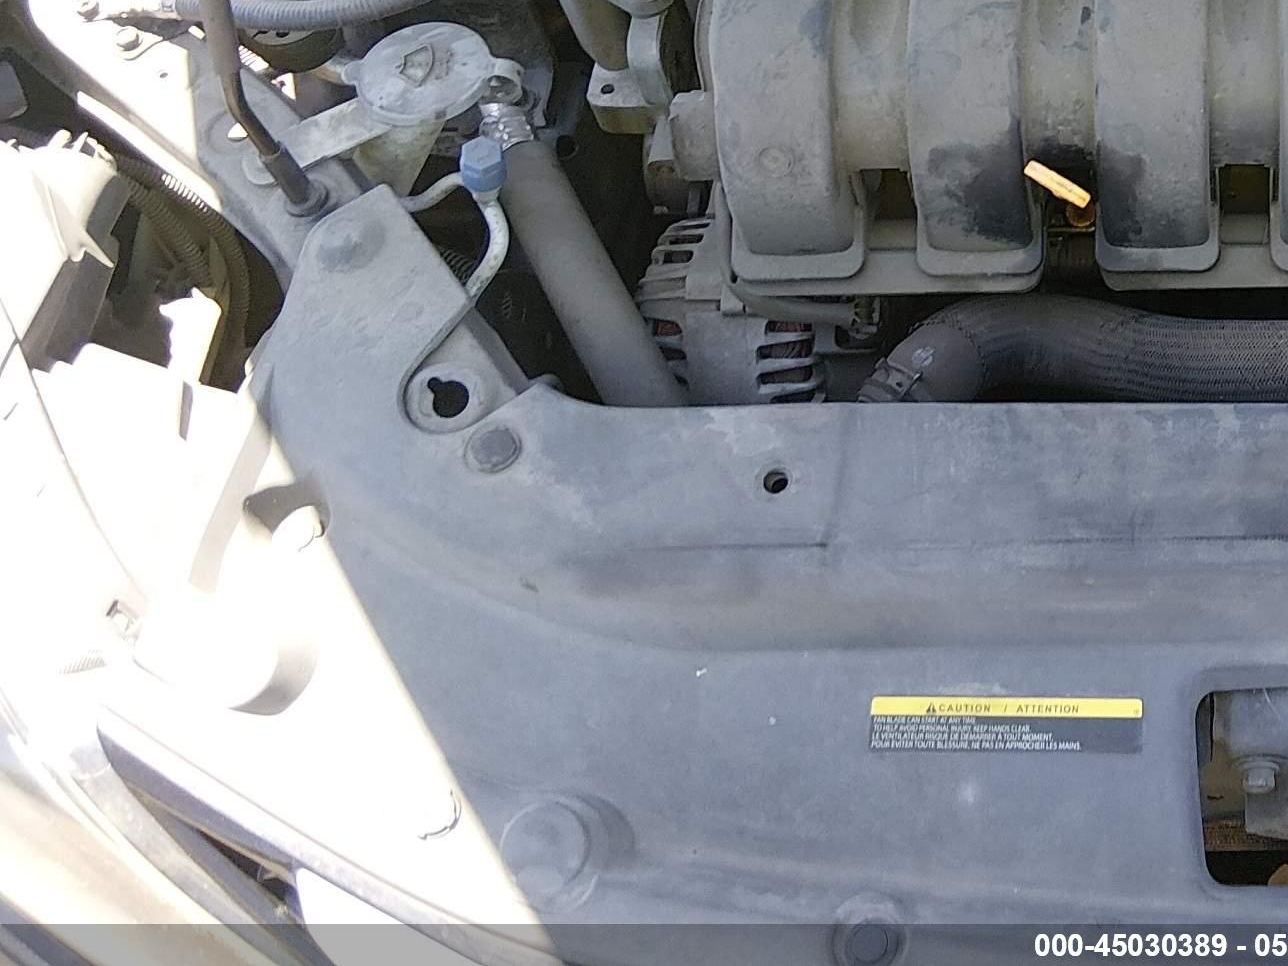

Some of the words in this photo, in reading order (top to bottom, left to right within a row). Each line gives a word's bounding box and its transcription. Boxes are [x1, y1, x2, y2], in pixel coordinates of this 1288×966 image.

[938, 704, 991, 713] CAUTION
[1016, 704, 1079, 714] ATTENTION
[907, 716, 920, 724] CAN
[921, 716, 938, 724] START
[882, 724, 898, 732] HELP
[898, 724, 918, 732] AVOID
[919, 724, 950, 732] PERSONAL
[989, 724, 1010, 732] HANDS
[870, 741, 890, 749] POUR
[914, 741, 936, 749] TOUTE
[981, 741, 994, 749] PAS
[995, 741, 1005, 750] EN
[1005, 742, 1045, 750] APPROCHER
[1046, 742, 1057, 750] LES
